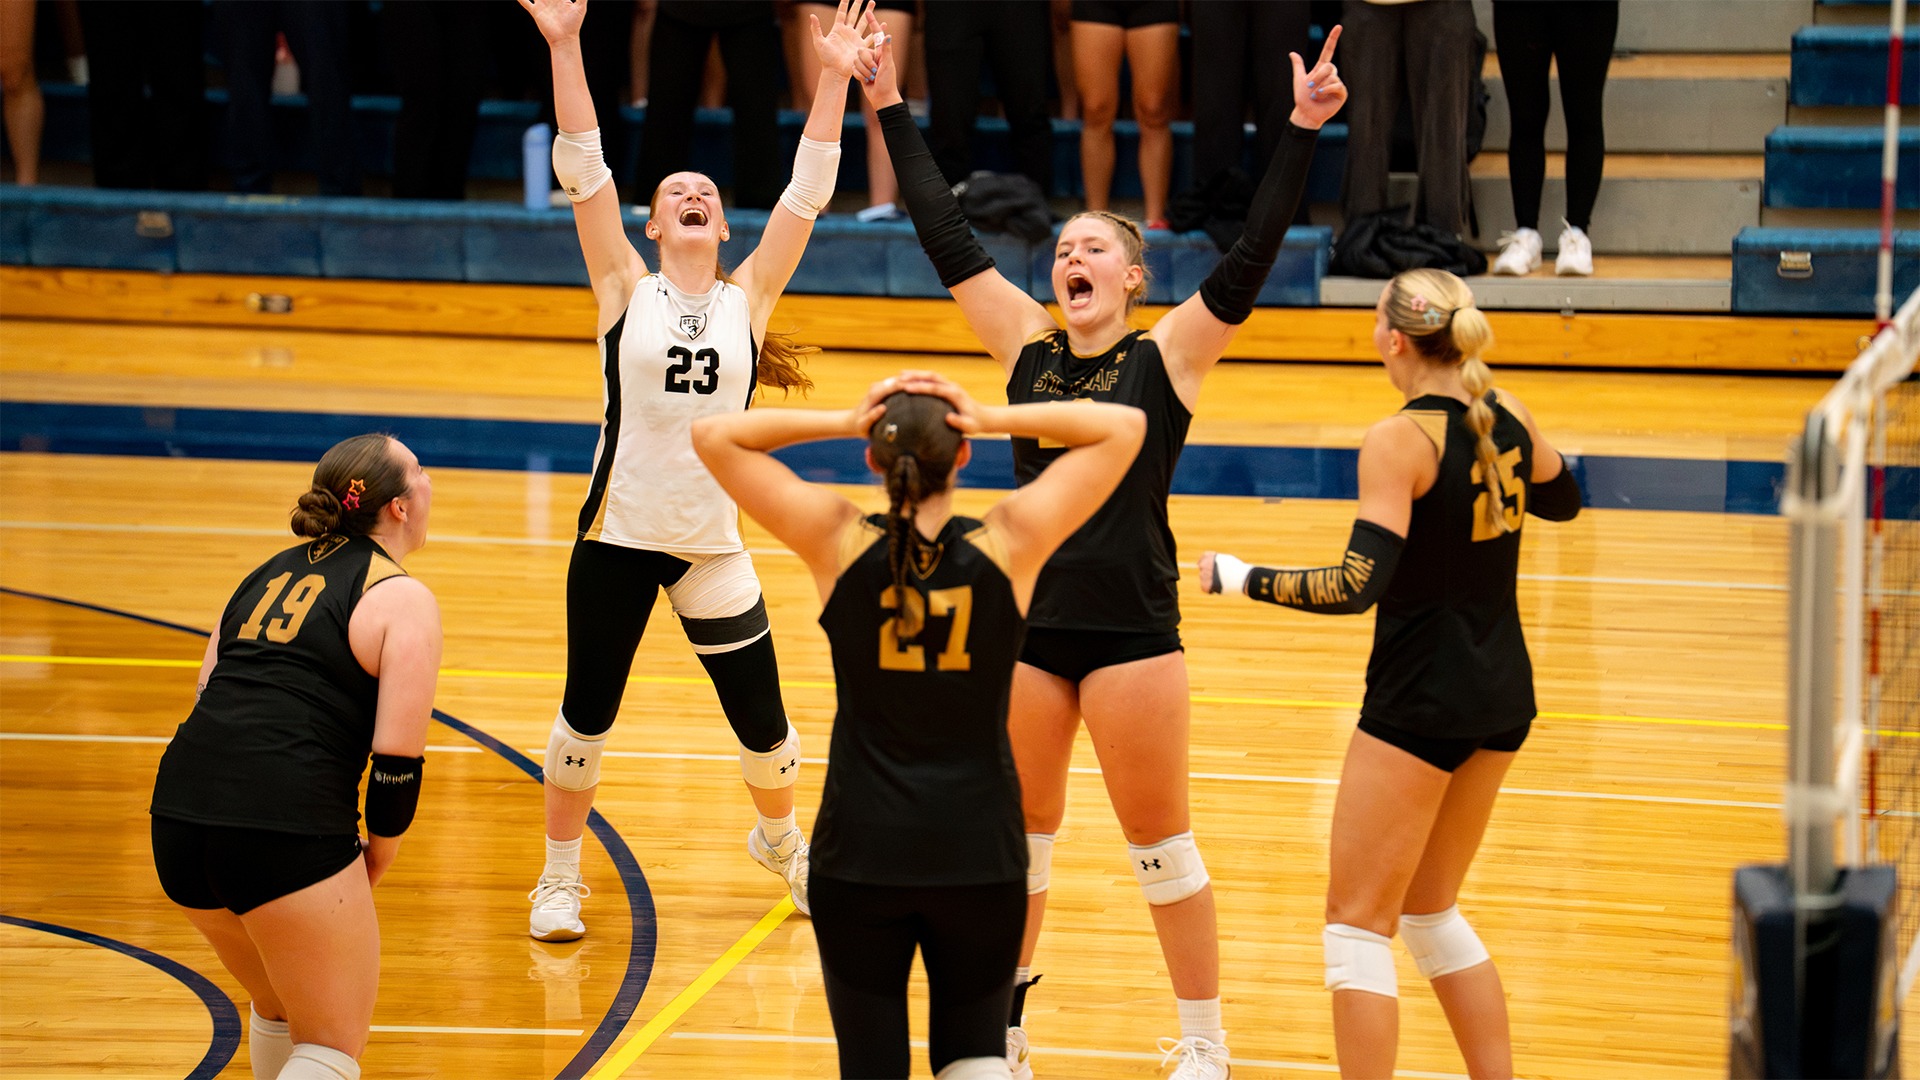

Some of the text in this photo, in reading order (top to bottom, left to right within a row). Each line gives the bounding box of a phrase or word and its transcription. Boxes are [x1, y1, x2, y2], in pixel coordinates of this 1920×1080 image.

[665, 345, 720, 395] 23
[1470, 446, 1526, 543] 25
[237, 571, 326, 644] 19
[1306, 567, 1349, 605] YAH!
[879, 584, 973, 672] 27
